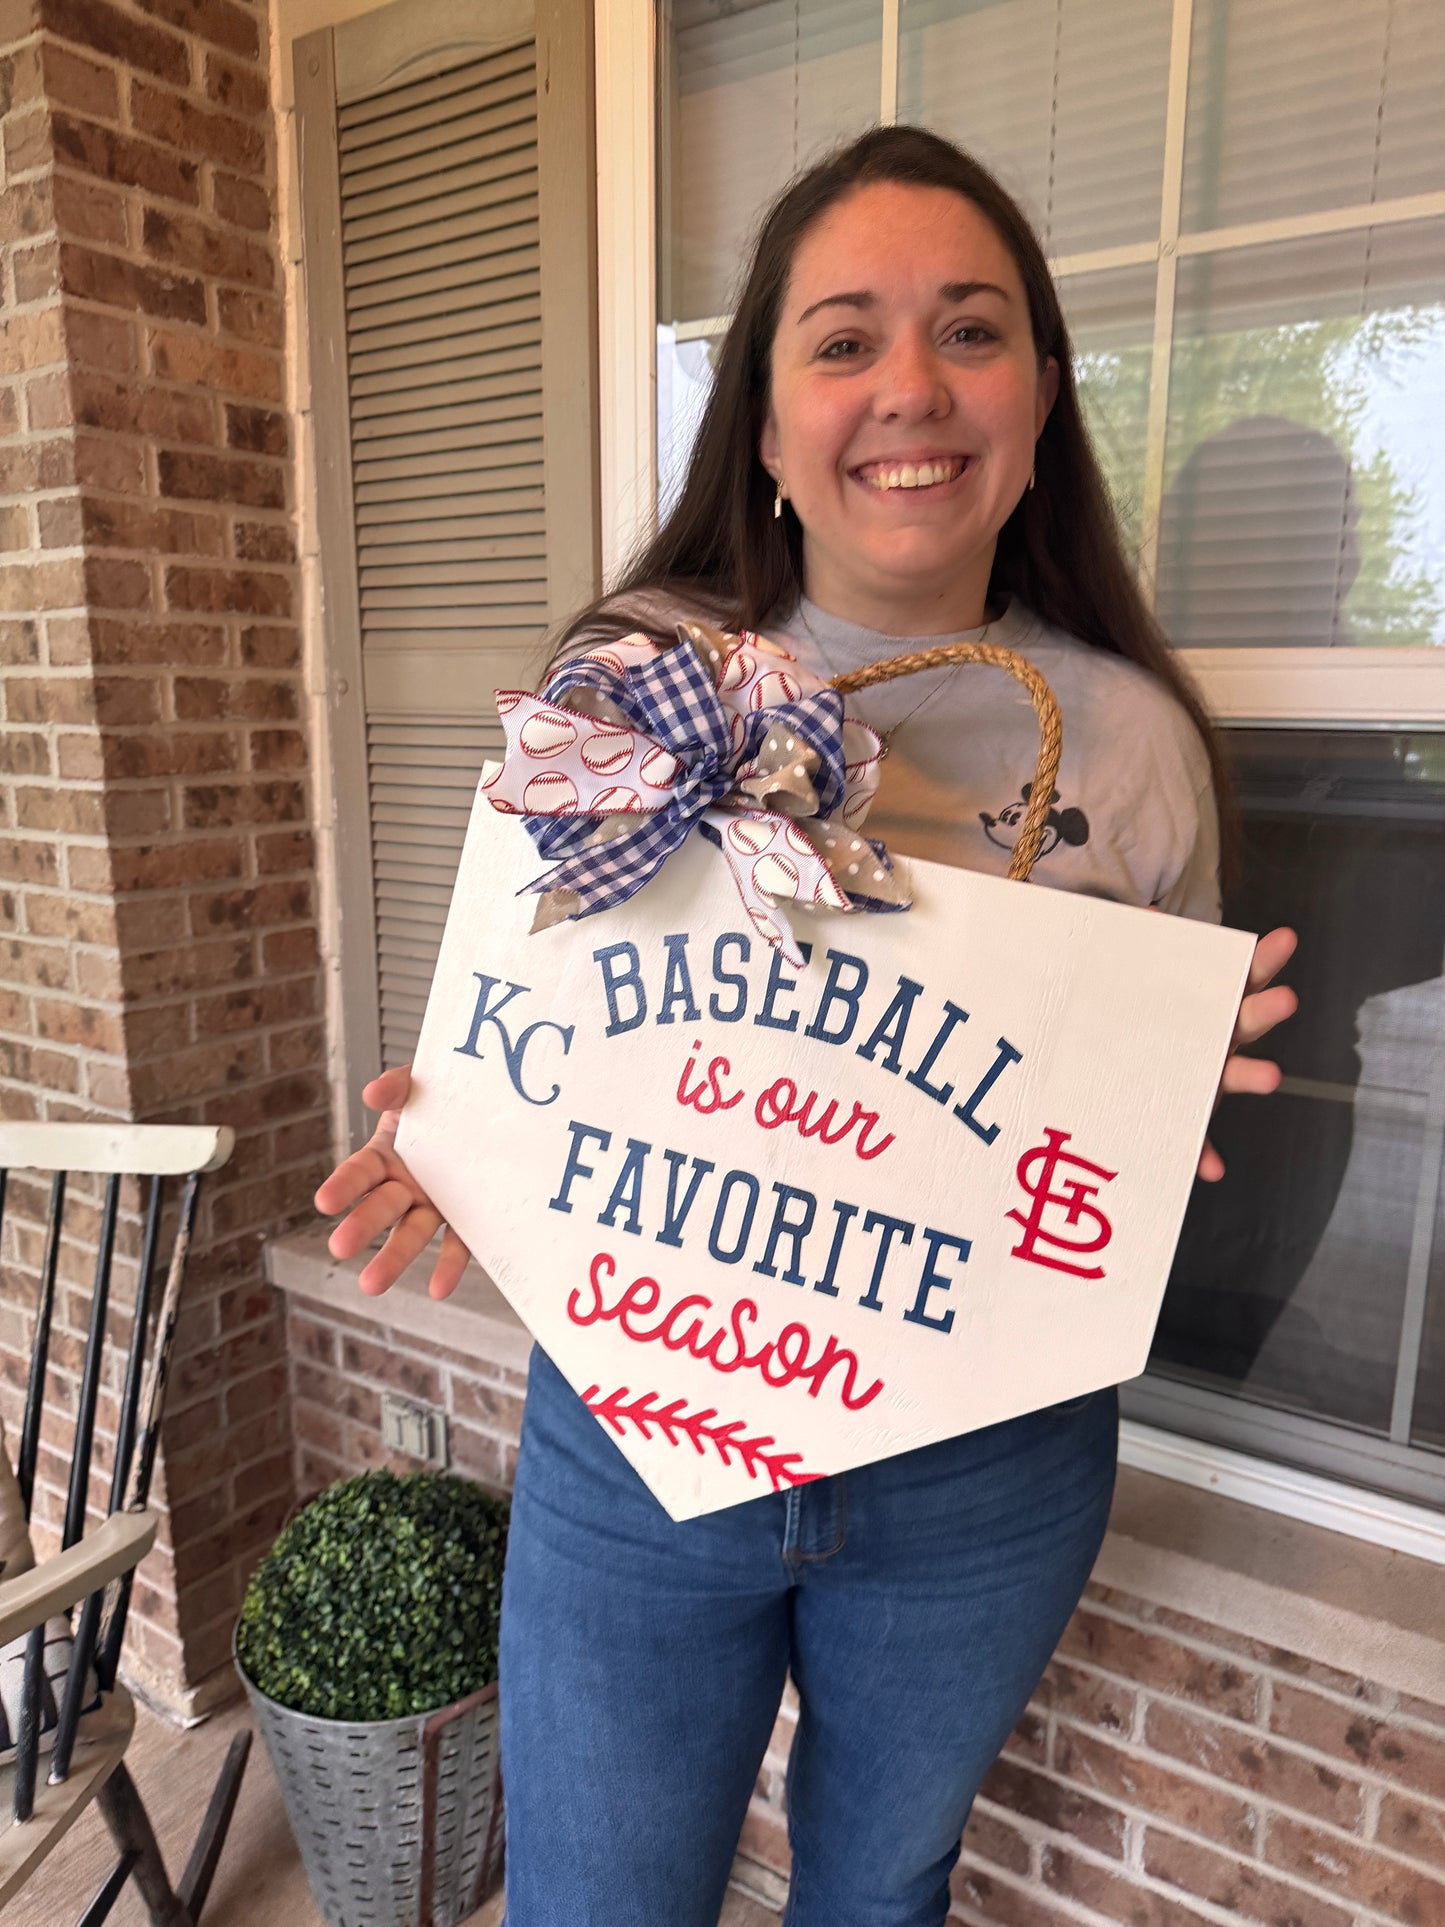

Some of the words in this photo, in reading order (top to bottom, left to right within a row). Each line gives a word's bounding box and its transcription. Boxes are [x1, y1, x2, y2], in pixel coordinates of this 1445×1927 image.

[453, 972, 575, 1106] KC
[593, 932, 1023, 1146] BASEBALL
[677, 1040, 744, 1114] is
[755, 1077, 896, 1160] our
[548, 1121, 973, 1335] FAVORITE
[567, 1252, 884, 1411] season
